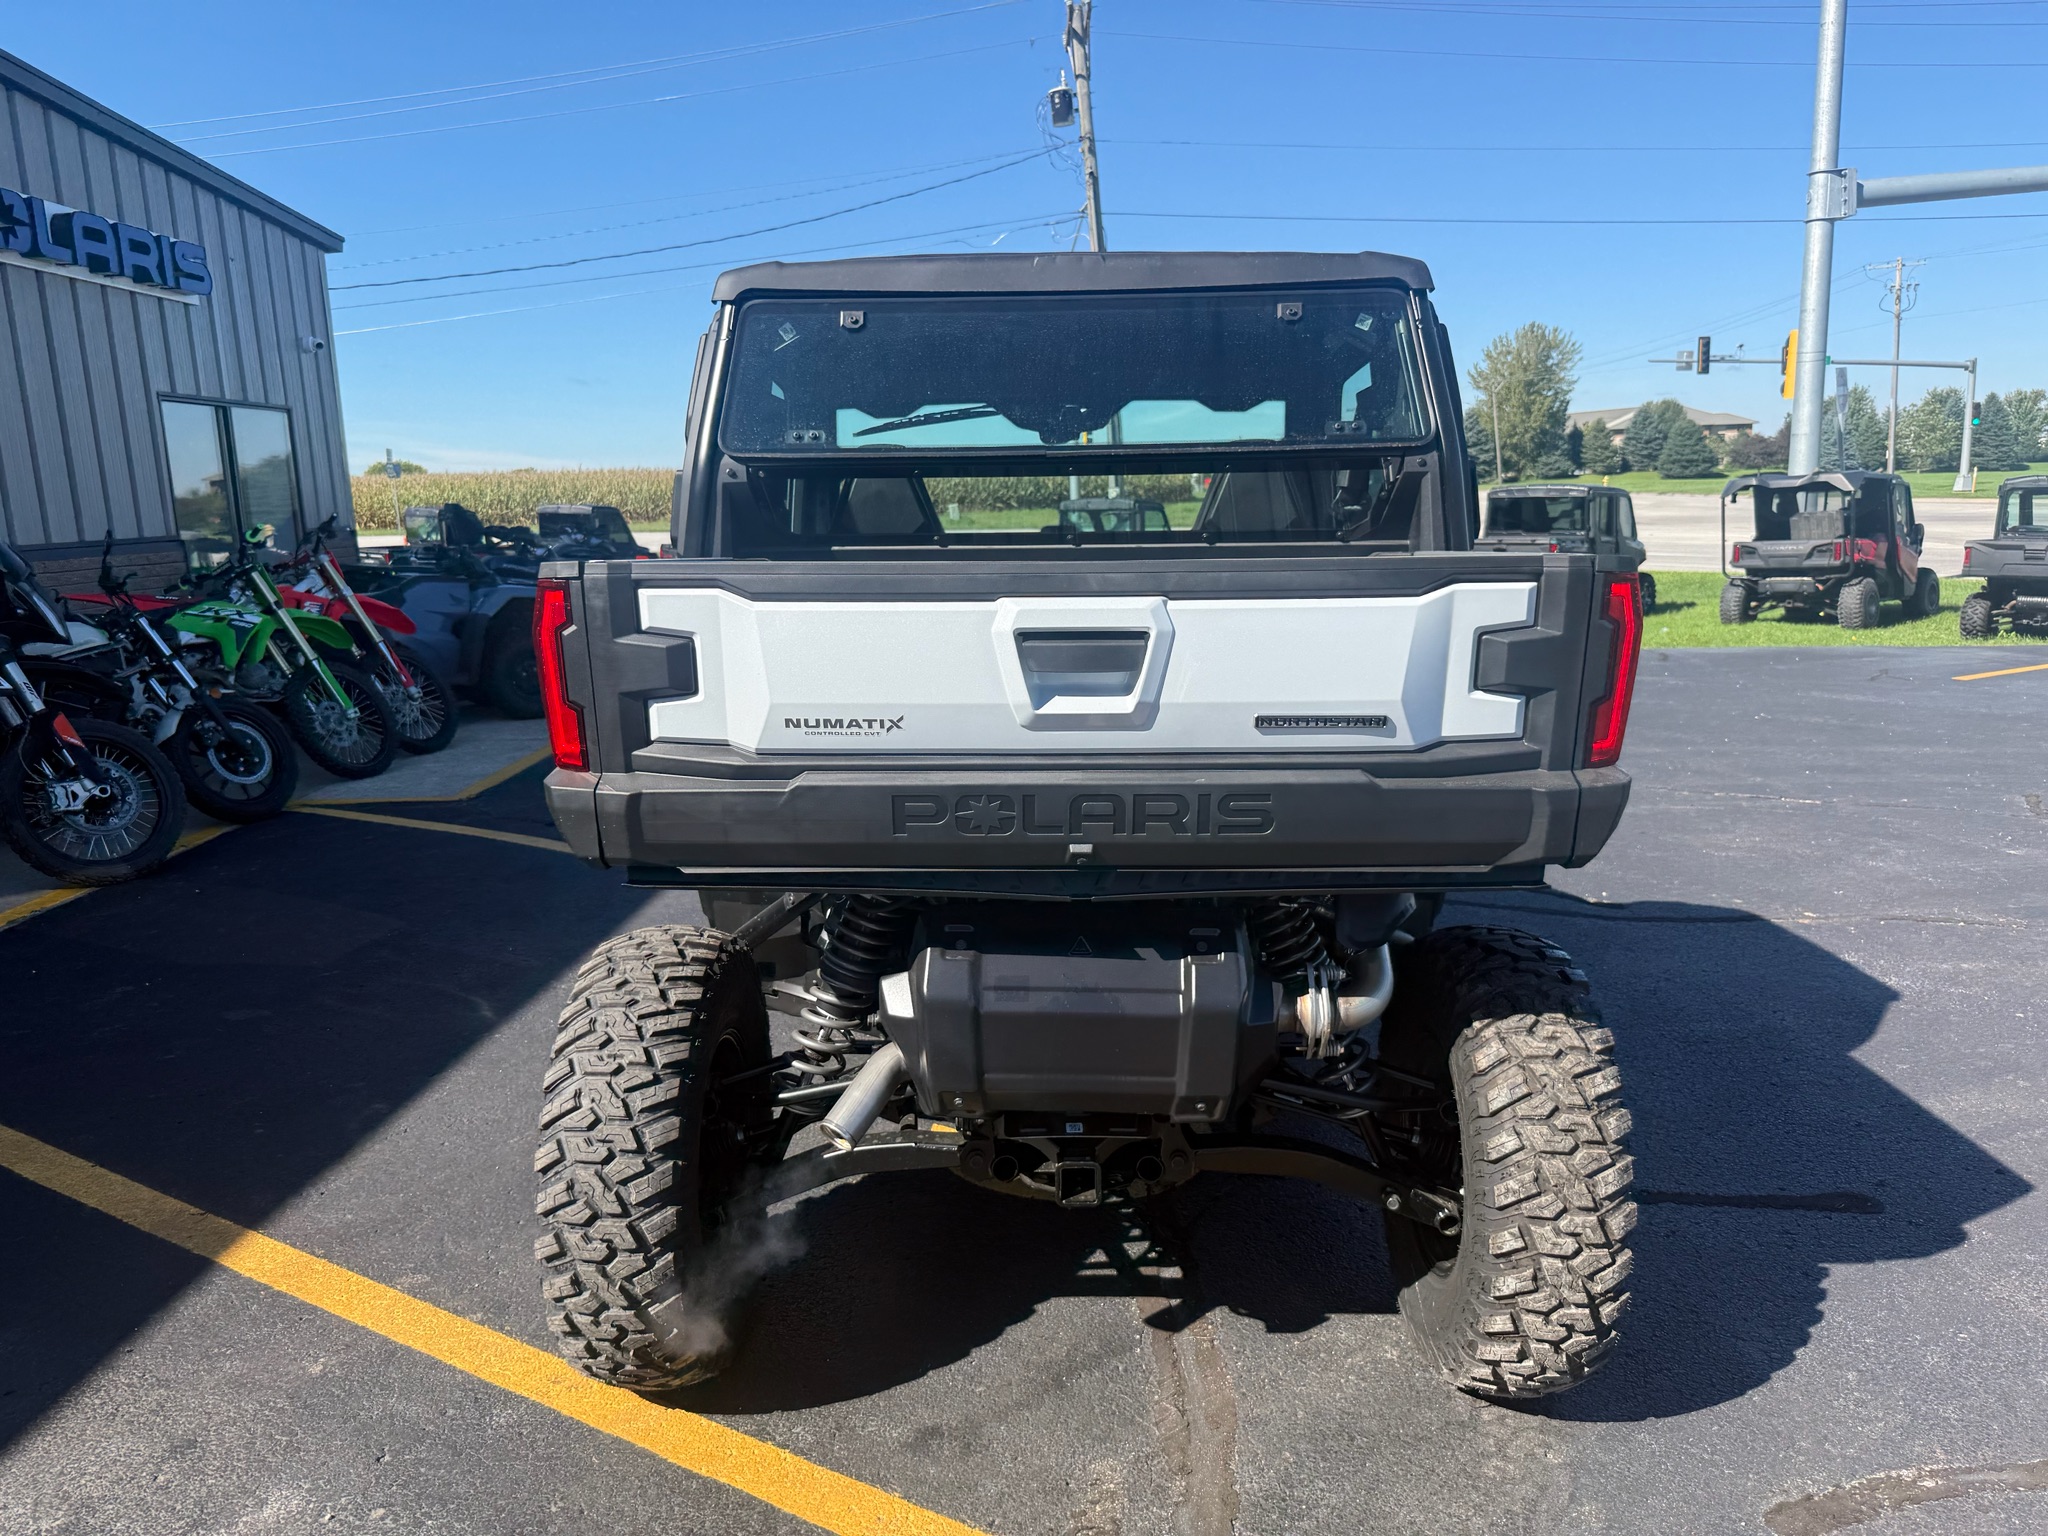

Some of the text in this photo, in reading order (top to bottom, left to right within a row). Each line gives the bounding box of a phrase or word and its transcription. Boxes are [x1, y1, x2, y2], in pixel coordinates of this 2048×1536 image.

[784, 715, 904, 733] NUMATIX
[1259, 716, 1383, 727] NORTHSTAR
[891, 793, 1276, 836] POLARIS
